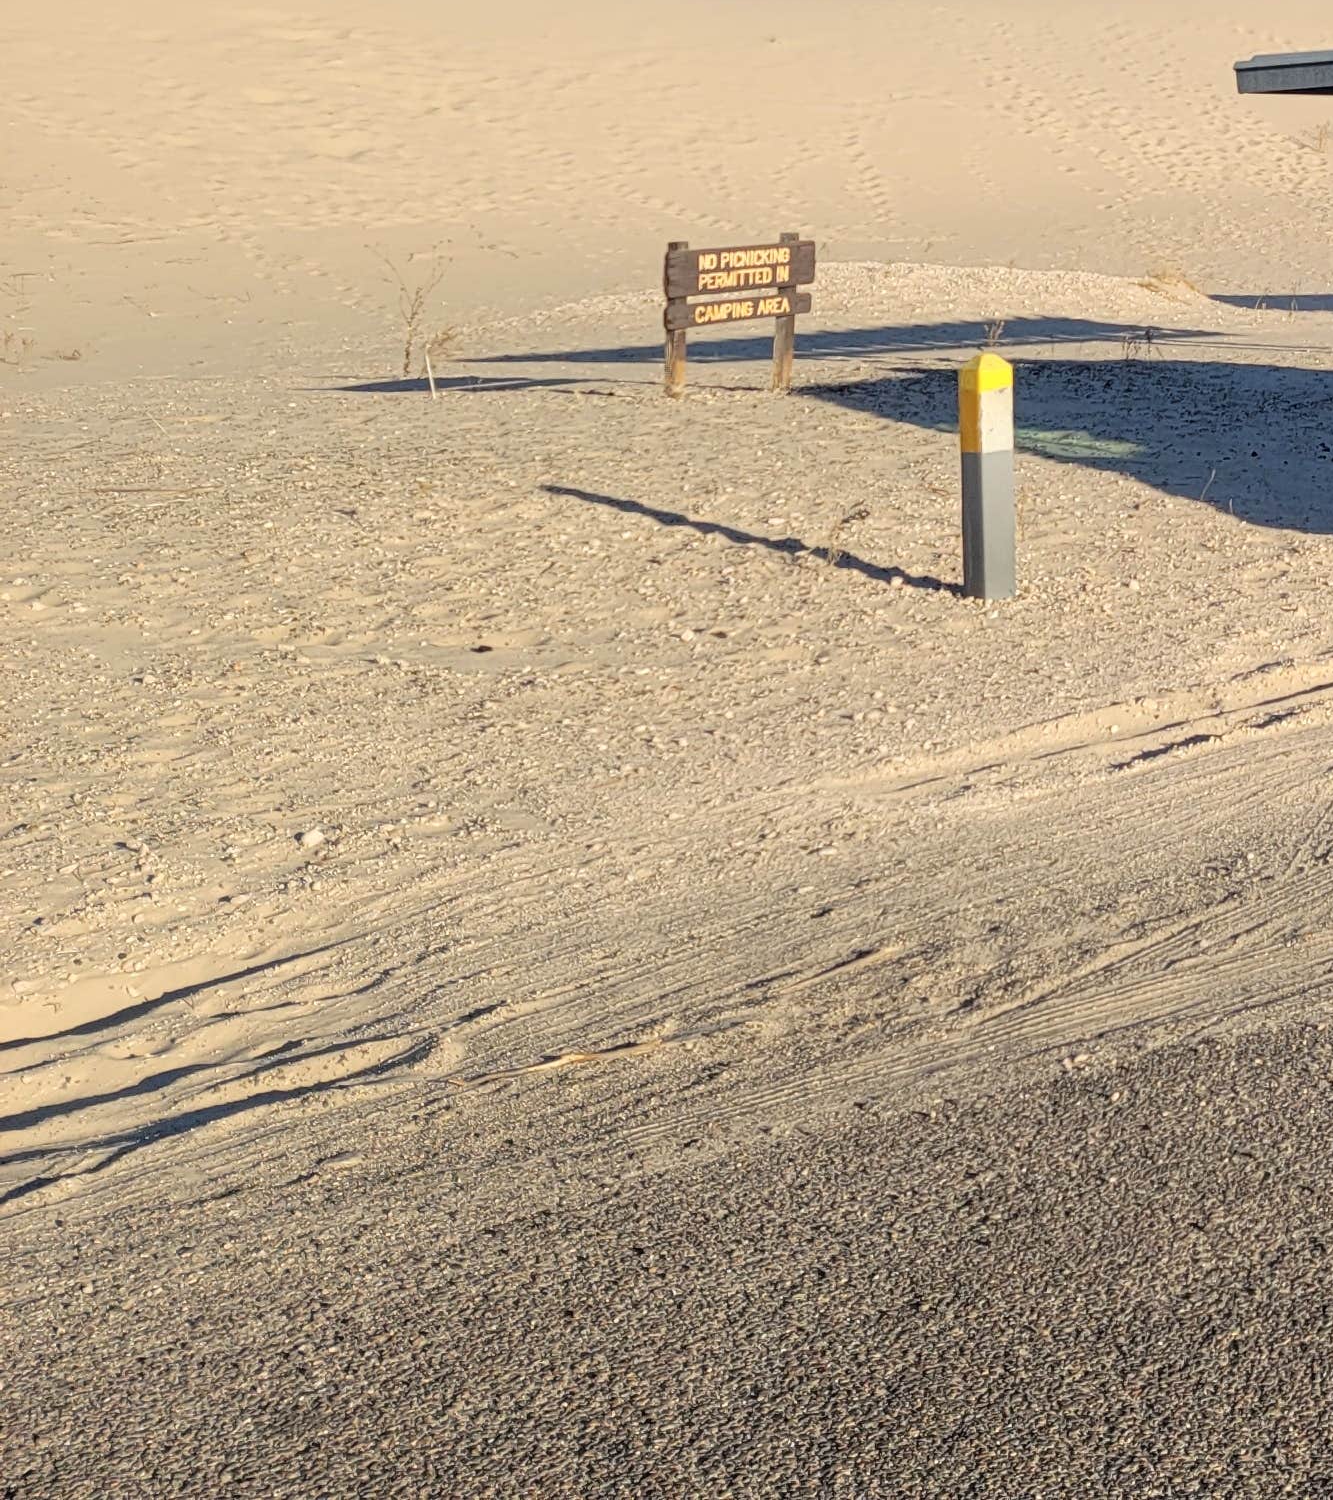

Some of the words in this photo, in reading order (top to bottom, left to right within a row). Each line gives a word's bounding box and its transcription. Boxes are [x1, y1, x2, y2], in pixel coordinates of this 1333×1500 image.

[698, 253, 717, 271] NO
[720, 247, 790, 269] PICNICKING
[698, 267, 772, 291] PERMITTED
[776, 265, 789, 283] IN
[695, 301, 754, 323] CAMPING
[757, 296, 790, 315] AREA
